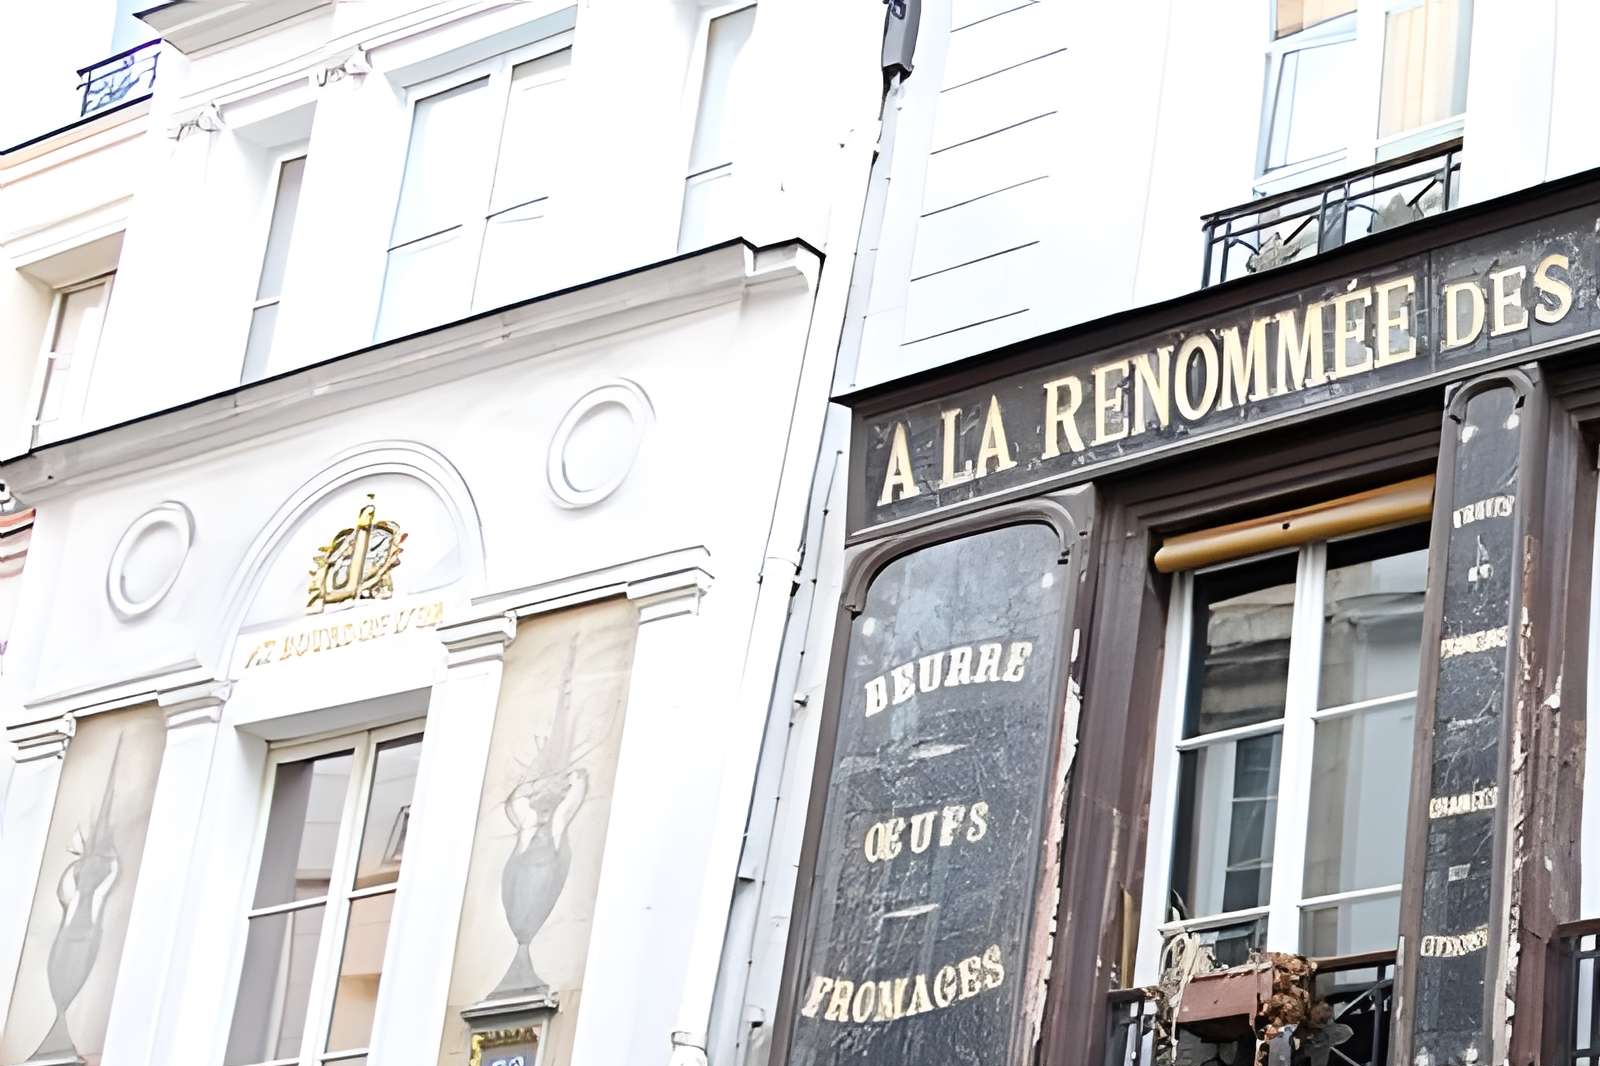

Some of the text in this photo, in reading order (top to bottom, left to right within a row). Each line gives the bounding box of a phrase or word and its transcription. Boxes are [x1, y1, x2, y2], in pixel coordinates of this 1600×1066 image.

[876, 421, 921, 506] A
[938, 394, 1018, 490] LA
[1041, 274, 1418, 461] RENOMMÉE
[1440, 253, 1573, 352] DES
[864, 641, 1033, 718] BEURRE
[801, 943, 1006, 1024] FROMAGES
